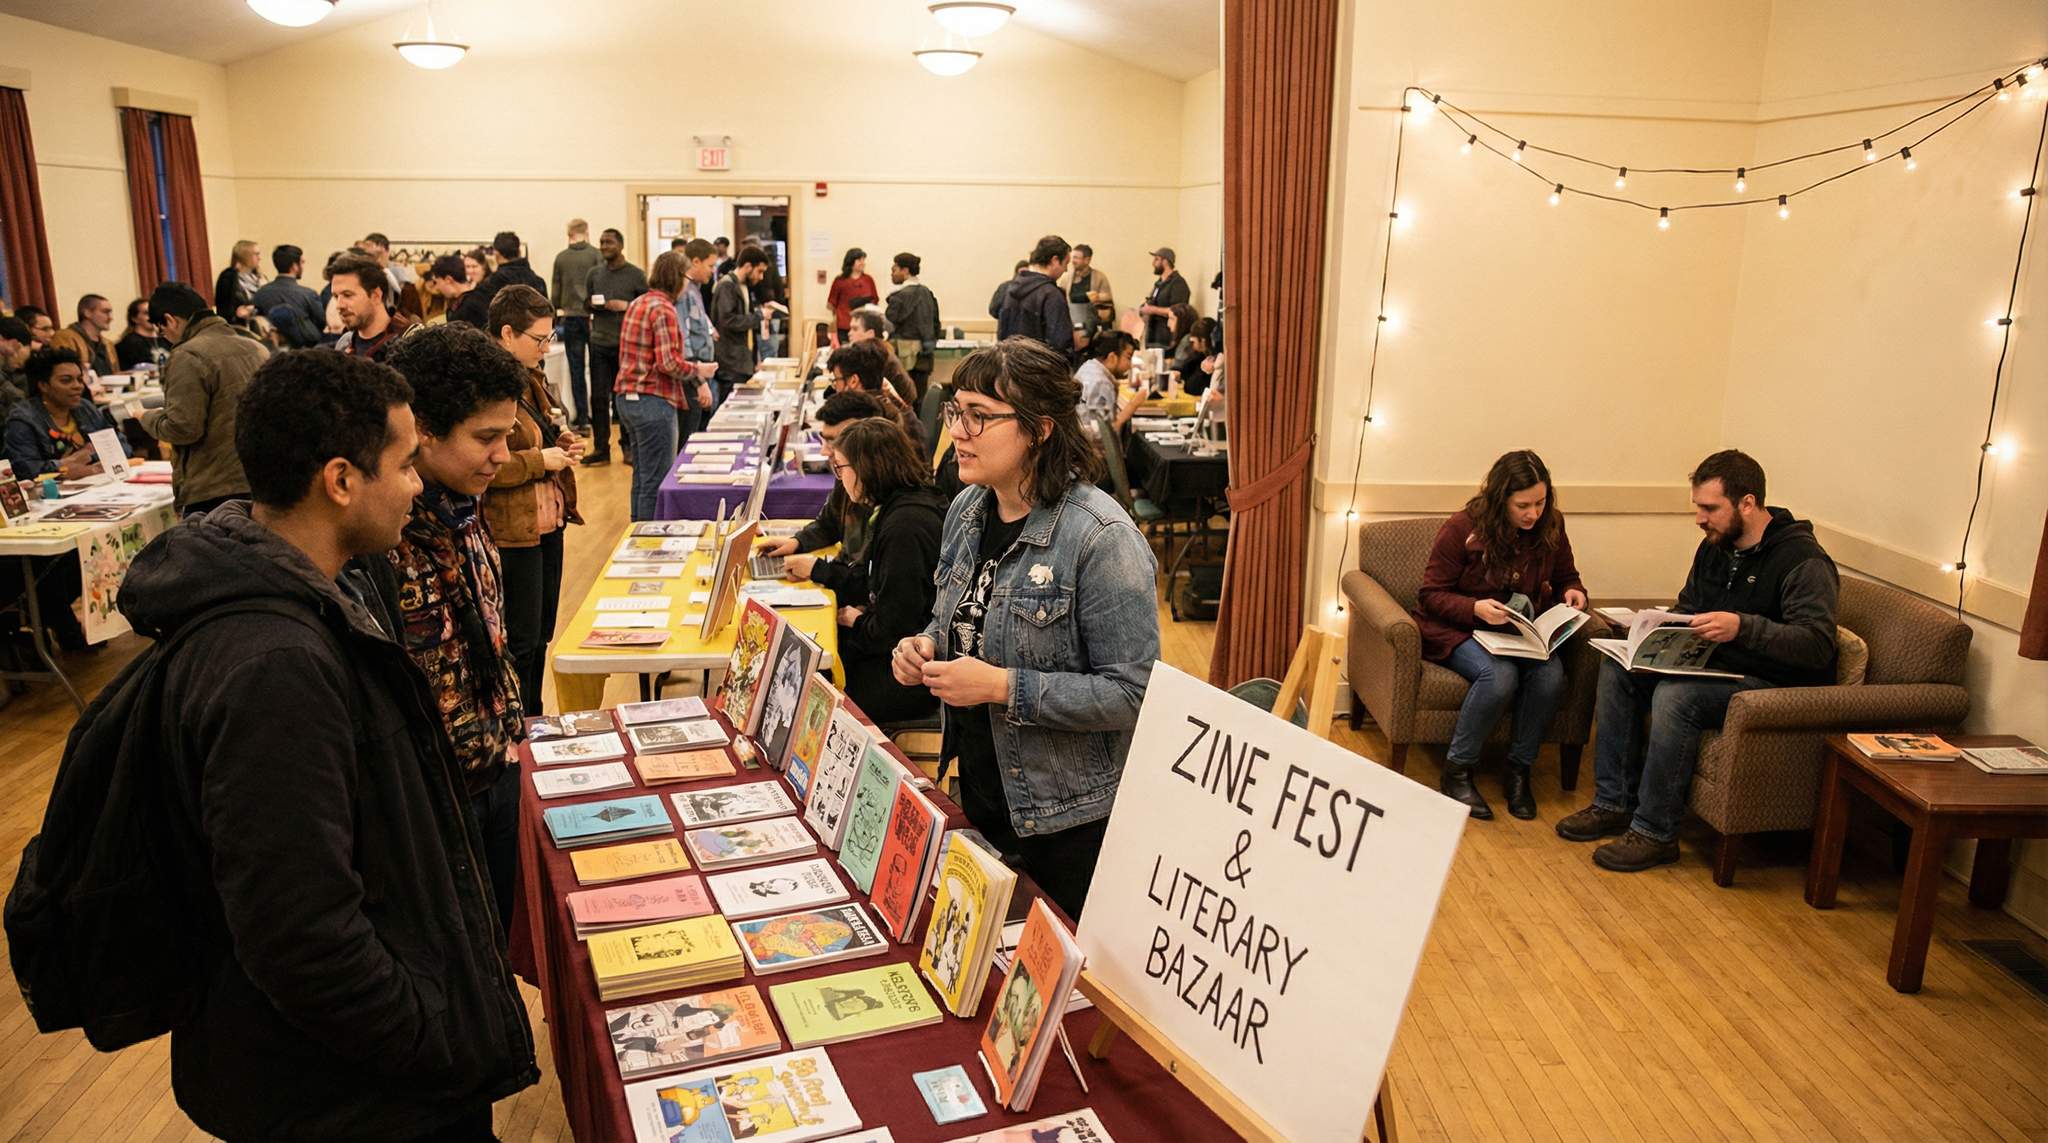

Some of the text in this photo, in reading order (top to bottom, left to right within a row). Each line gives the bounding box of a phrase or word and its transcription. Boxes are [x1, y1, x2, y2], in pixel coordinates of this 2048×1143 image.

[701, 149, 726, 167] EXIT
[1171, 715, 1384, 872] ZINE FEST
[1224, 829, 1252, 889] &
[1147, 854, 1309, 996] LITERARY
[1145, 926, 1269, 1065] BAZAAR
